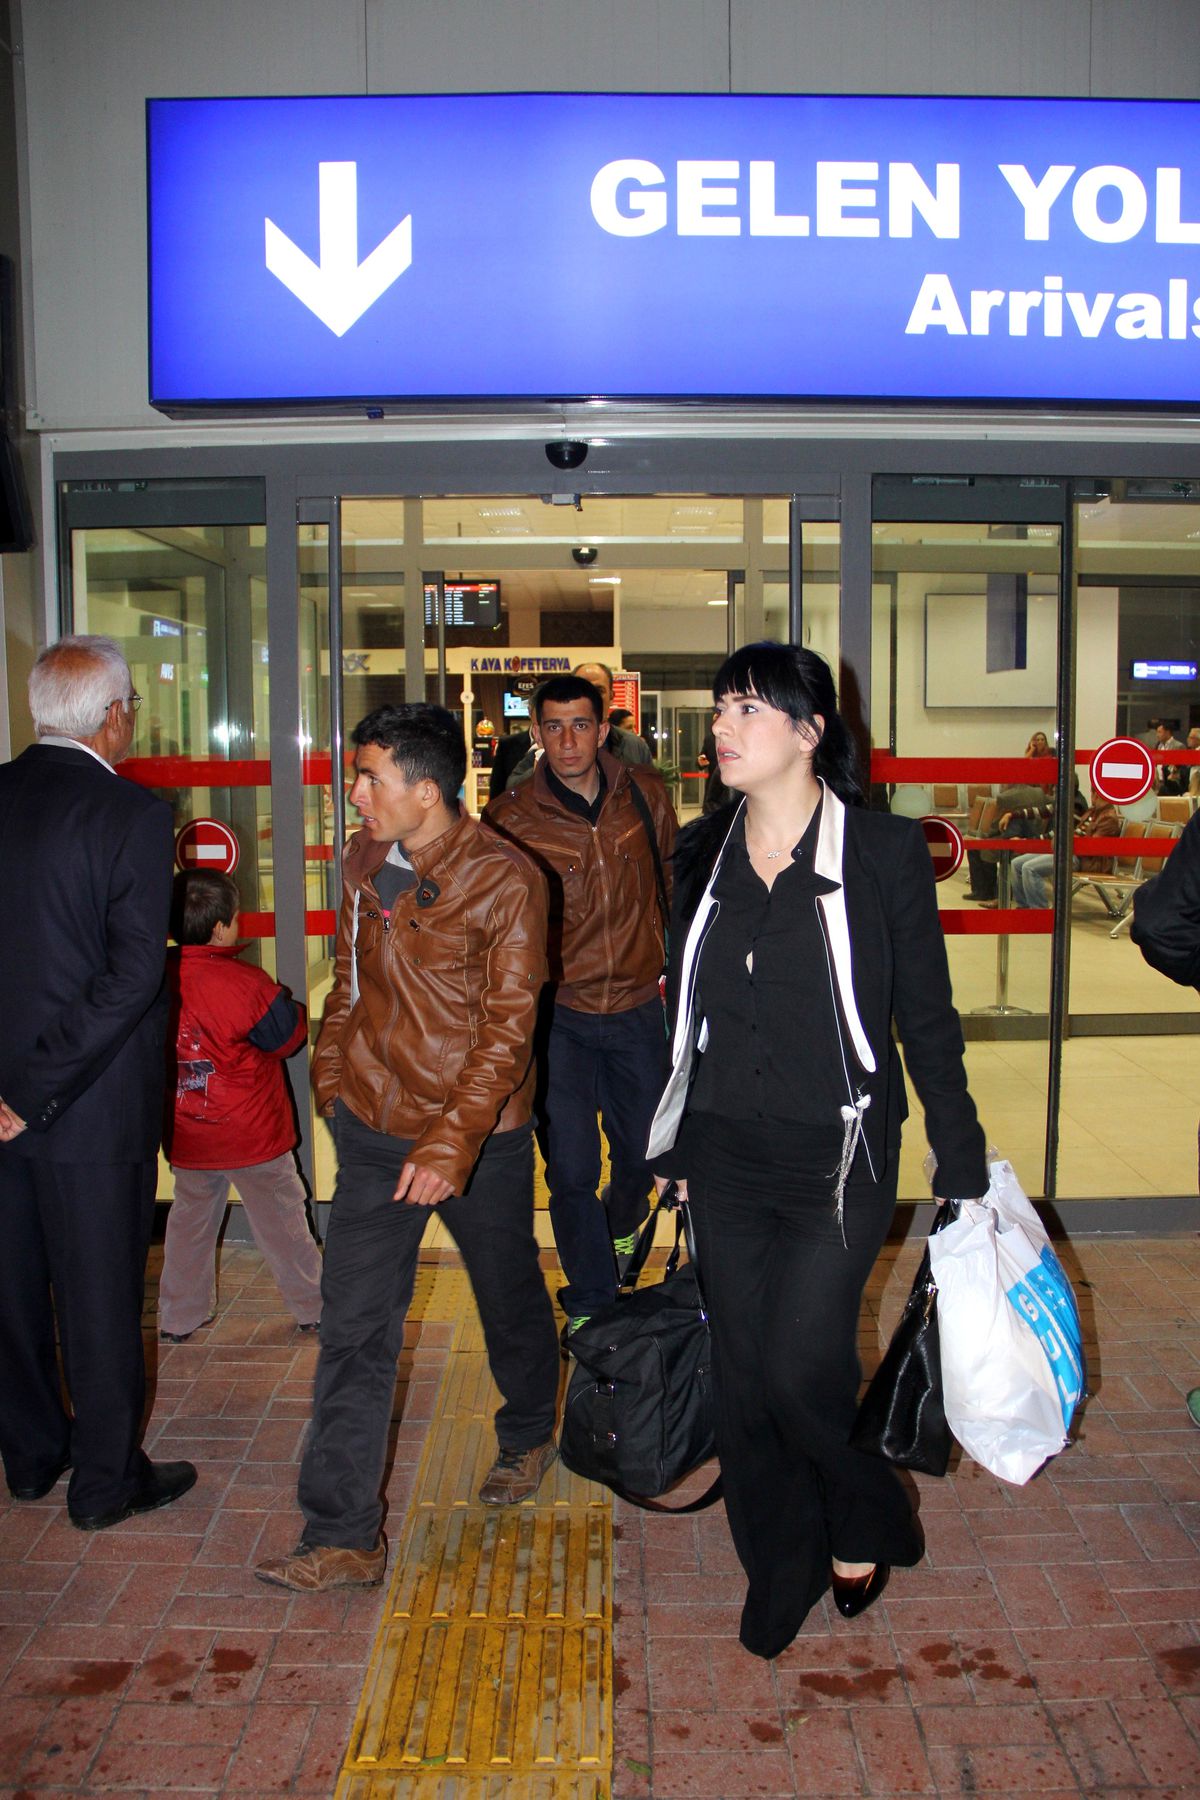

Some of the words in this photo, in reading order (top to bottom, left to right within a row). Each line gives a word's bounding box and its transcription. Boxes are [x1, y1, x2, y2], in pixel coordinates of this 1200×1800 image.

[590, 159, 960, 238] GELEN
[998, 165, 1200, 244] YOL
[905, 274, 1200, 340] Arrival
[518, 682, 534, 690] EFES
